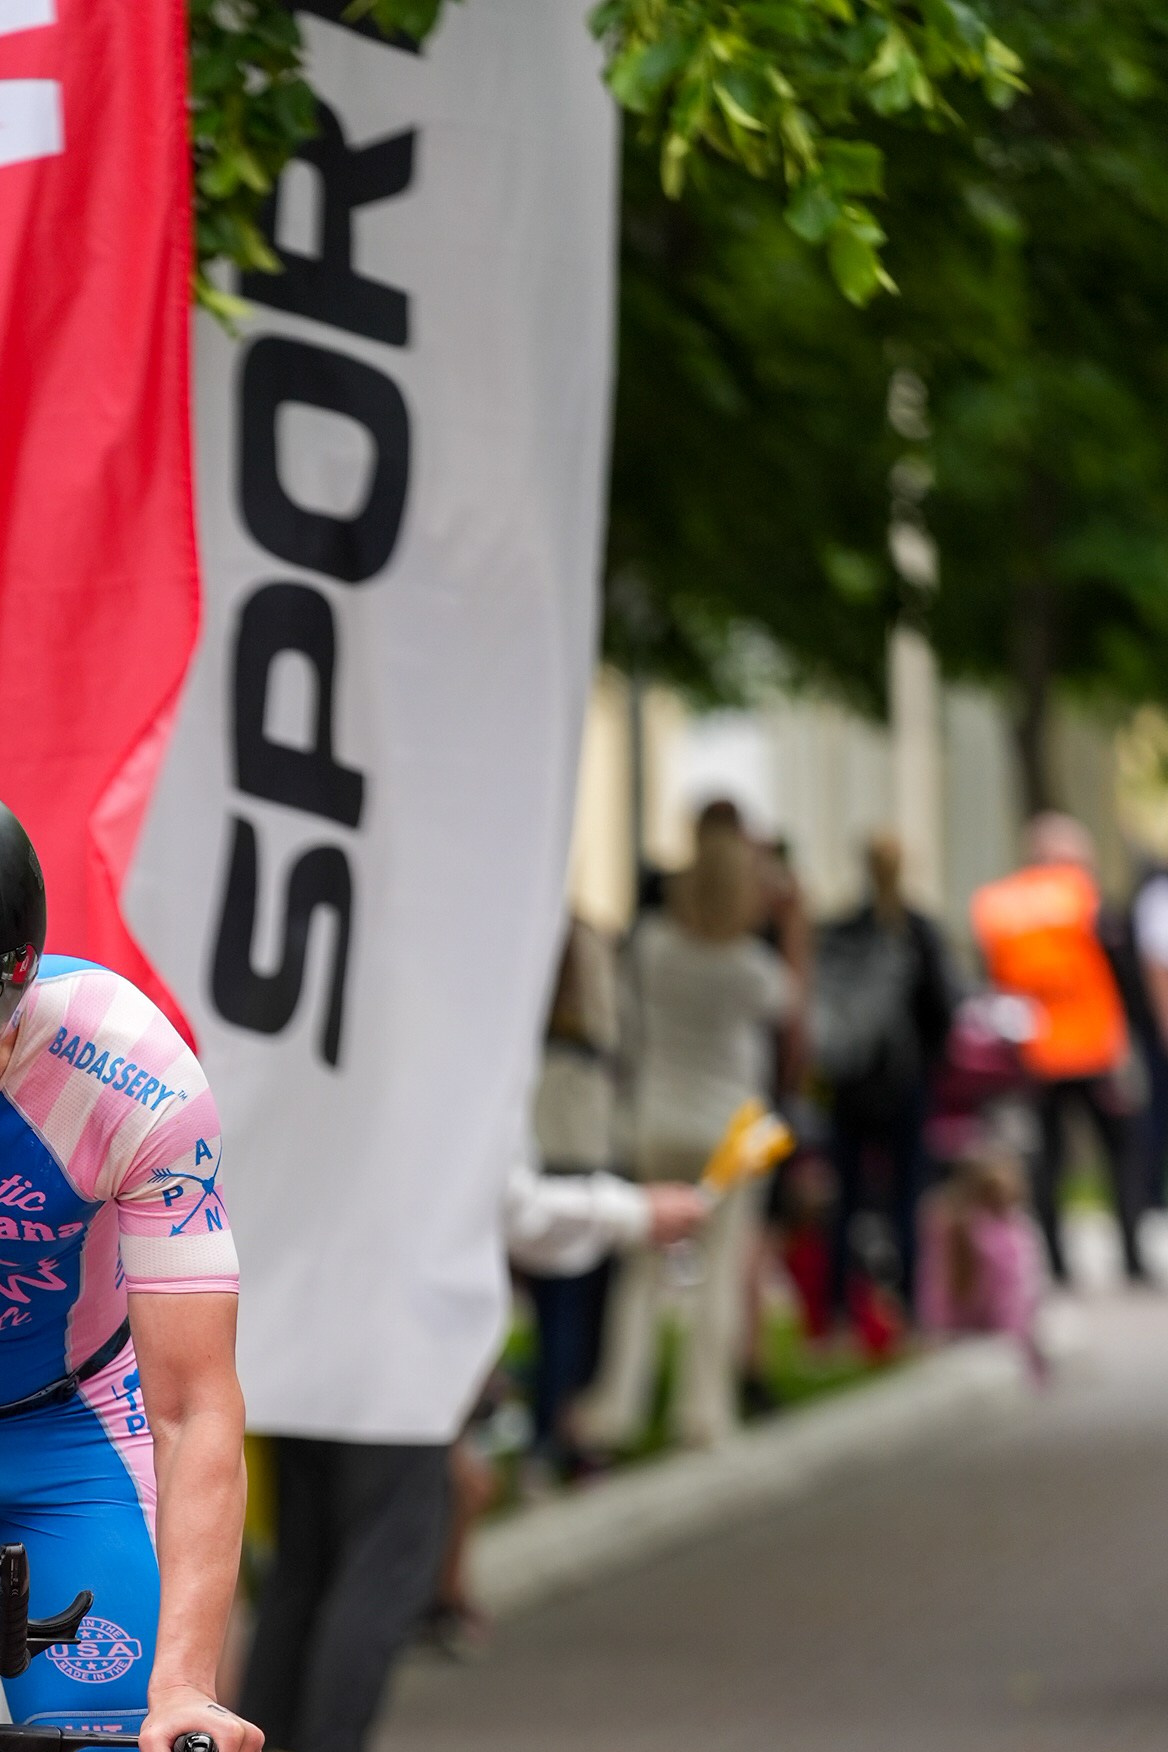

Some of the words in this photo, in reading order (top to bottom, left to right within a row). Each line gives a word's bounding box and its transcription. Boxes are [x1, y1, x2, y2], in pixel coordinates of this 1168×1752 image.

[48, 1026, 176, 1112] BADASSERY
[81, 1619, 95, 1627] IN
[99, 1622, 123, 1639] THE
[49, 1642, 135, 1658] USA
[58, 1660, 90, 1681] MADE
[92, 1672, 106, 1681] IN
[107, 1660, 129, 1678] THE
